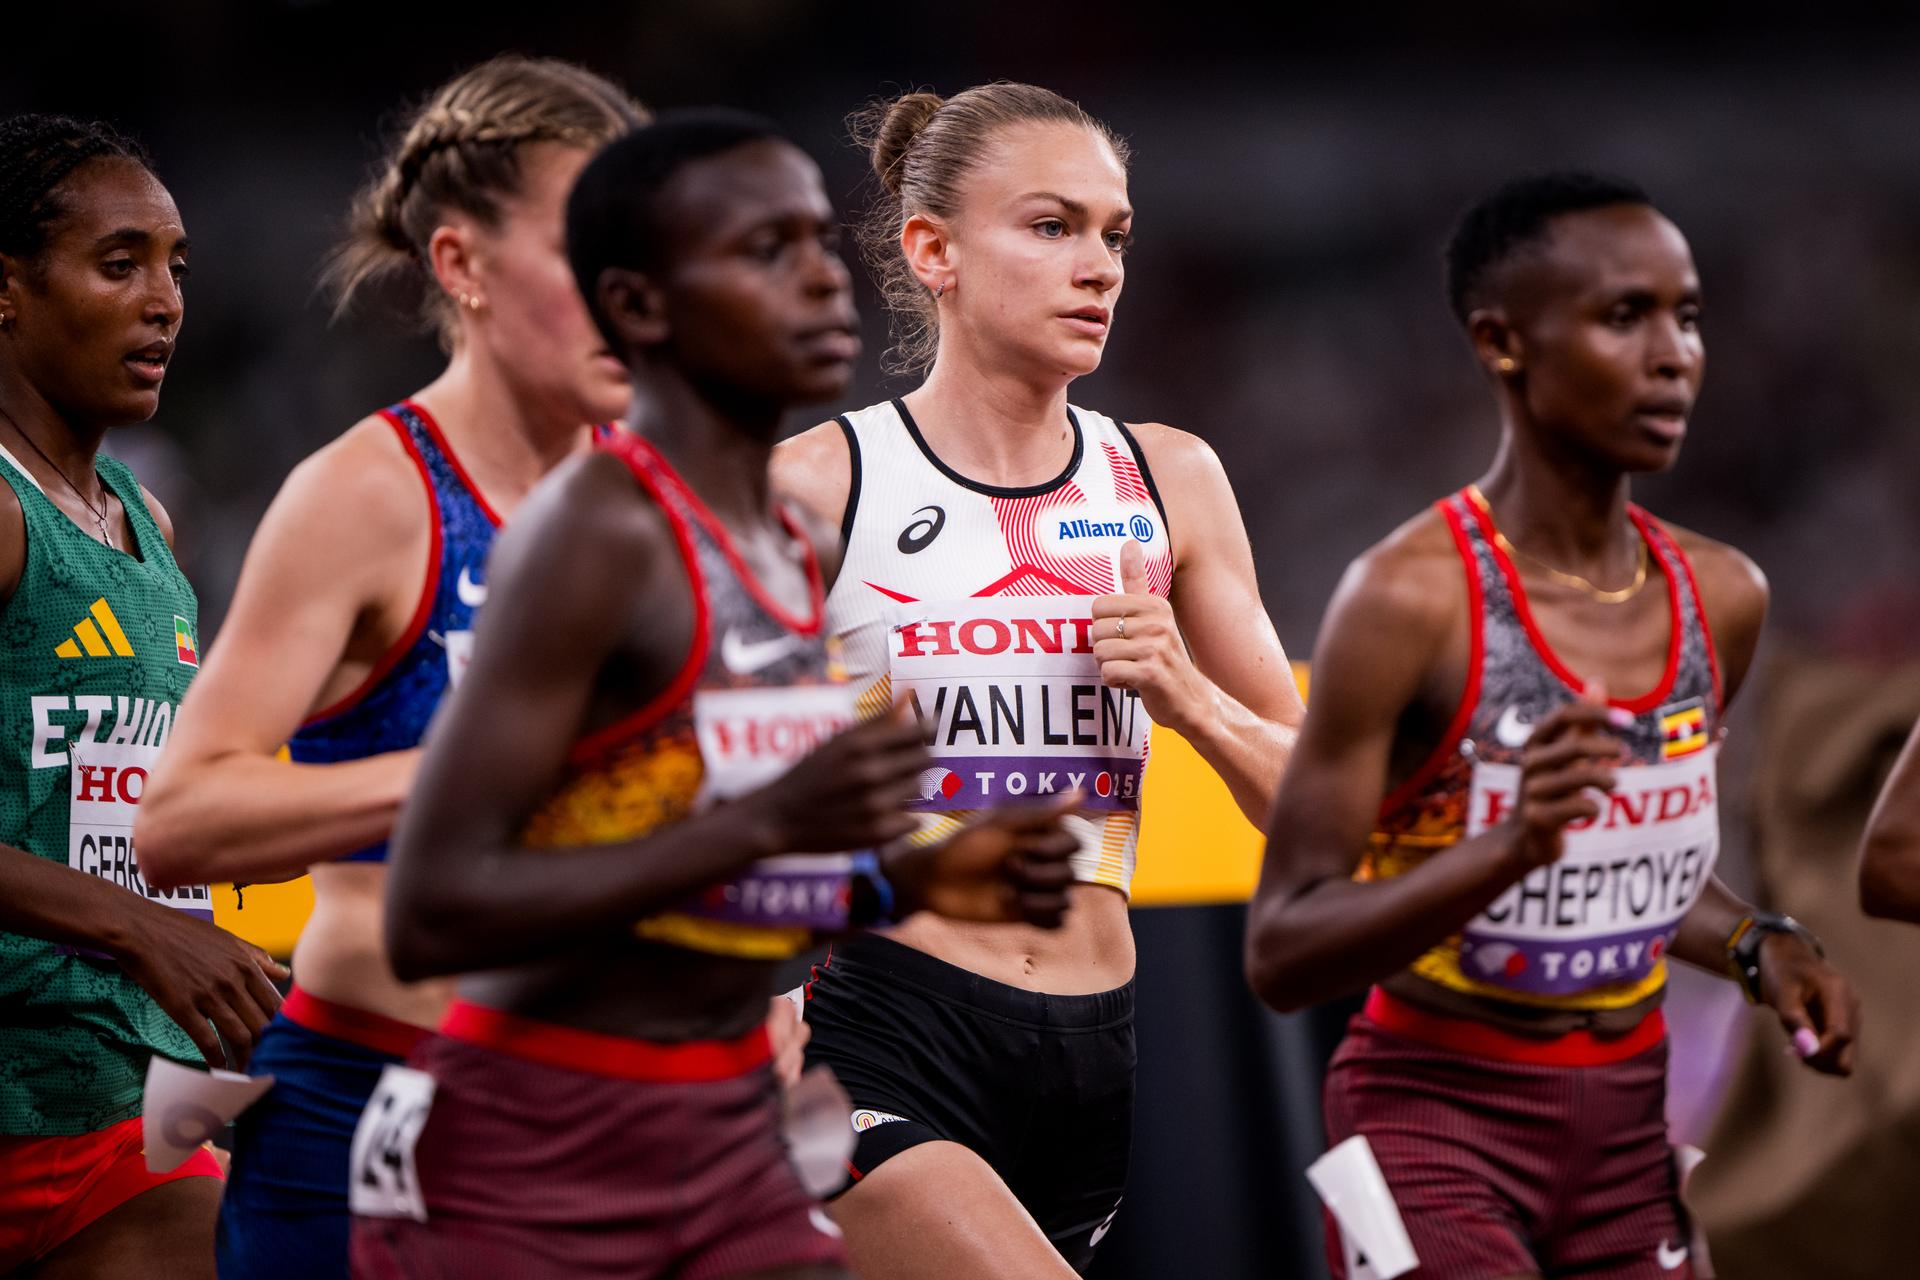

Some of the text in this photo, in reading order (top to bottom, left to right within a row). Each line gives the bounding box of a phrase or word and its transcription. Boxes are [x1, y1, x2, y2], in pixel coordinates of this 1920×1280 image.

[1058, 517, 1126, 540] Allianz
[31, 696, 180, 769] ETHIO
[908, 684, 1140, 748] VAN LENT
